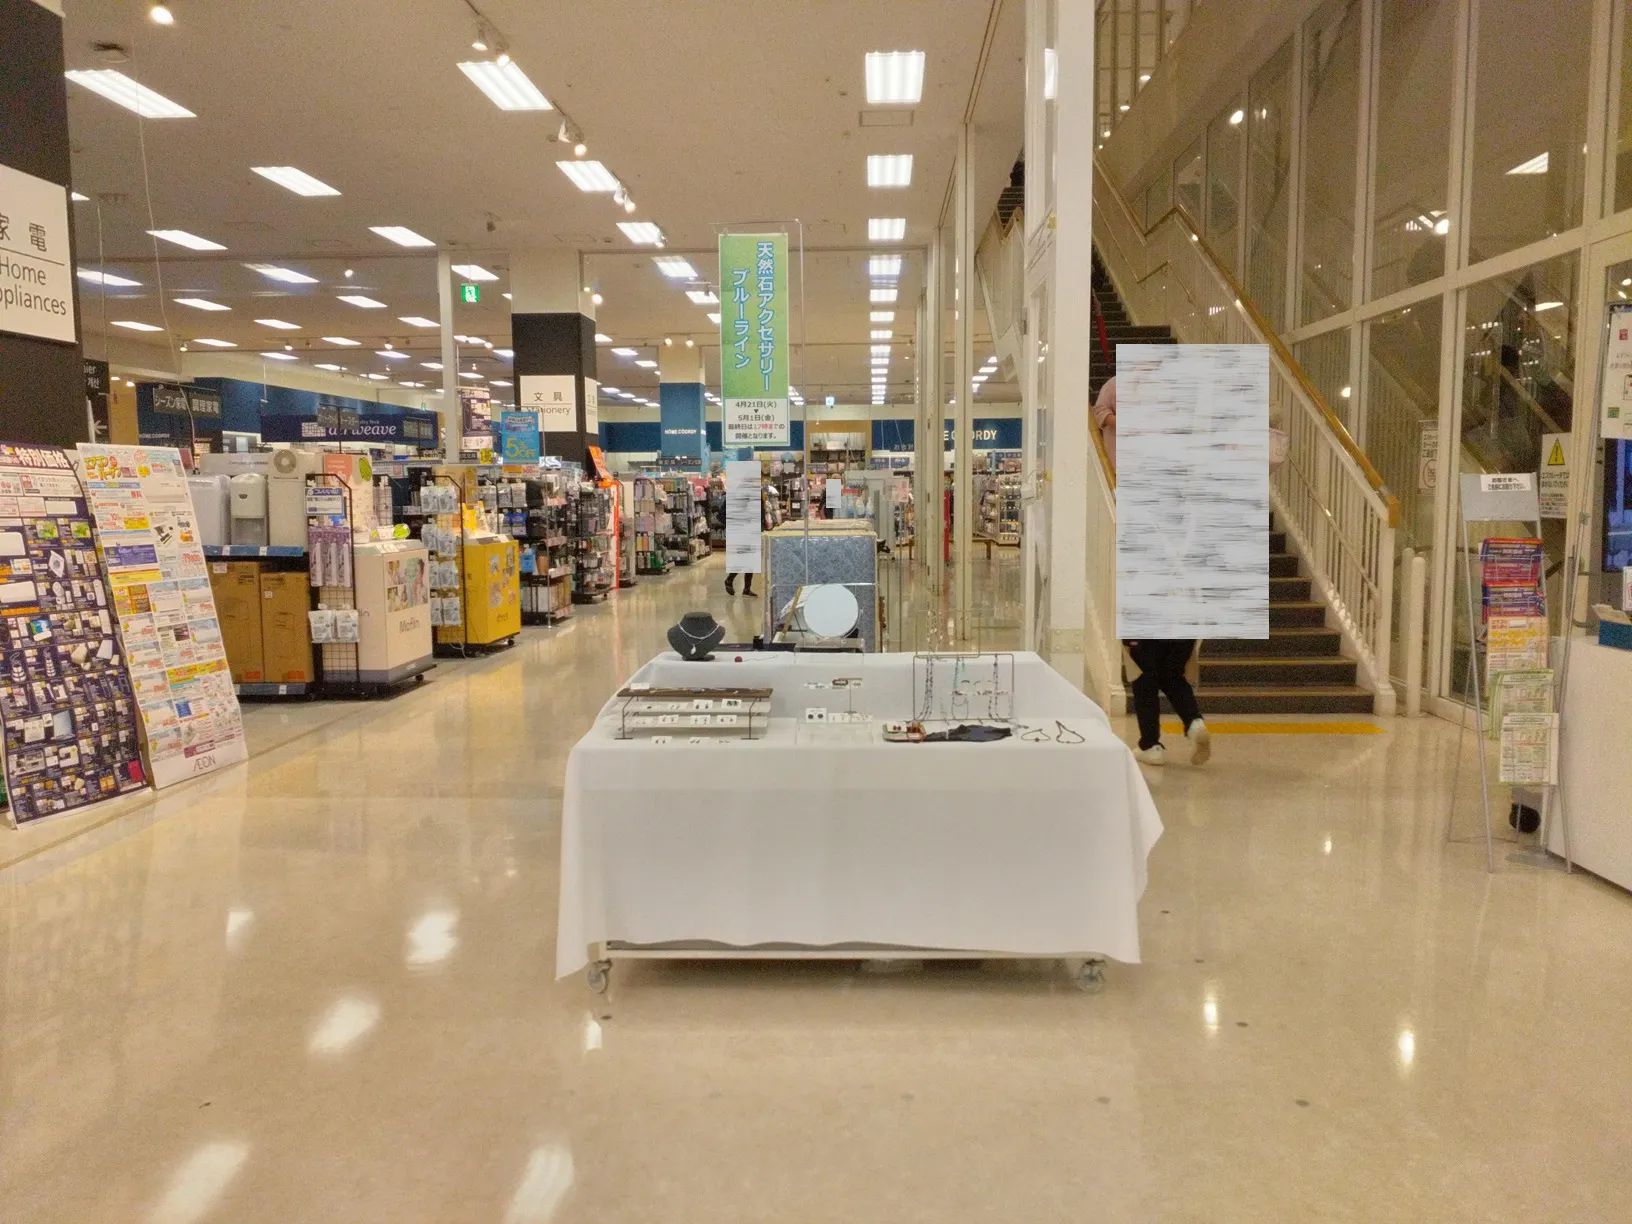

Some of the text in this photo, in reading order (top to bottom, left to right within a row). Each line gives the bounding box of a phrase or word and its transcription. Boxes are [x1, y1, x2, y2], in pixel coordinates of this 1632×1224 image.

[0, 256, 46, 286] Home
[0, 284, 67, 316] pliances
[732, 269, 750, 369] ブルーライン
[757, 241, 775, 391] 天然石アクセサリー
[534, 391, 563, 401] 文具
[735, 401, 777, 409] 4月21日(火)
[527, 405, 571, 415] Stationery
[328, 425, 397, 436] aweave
